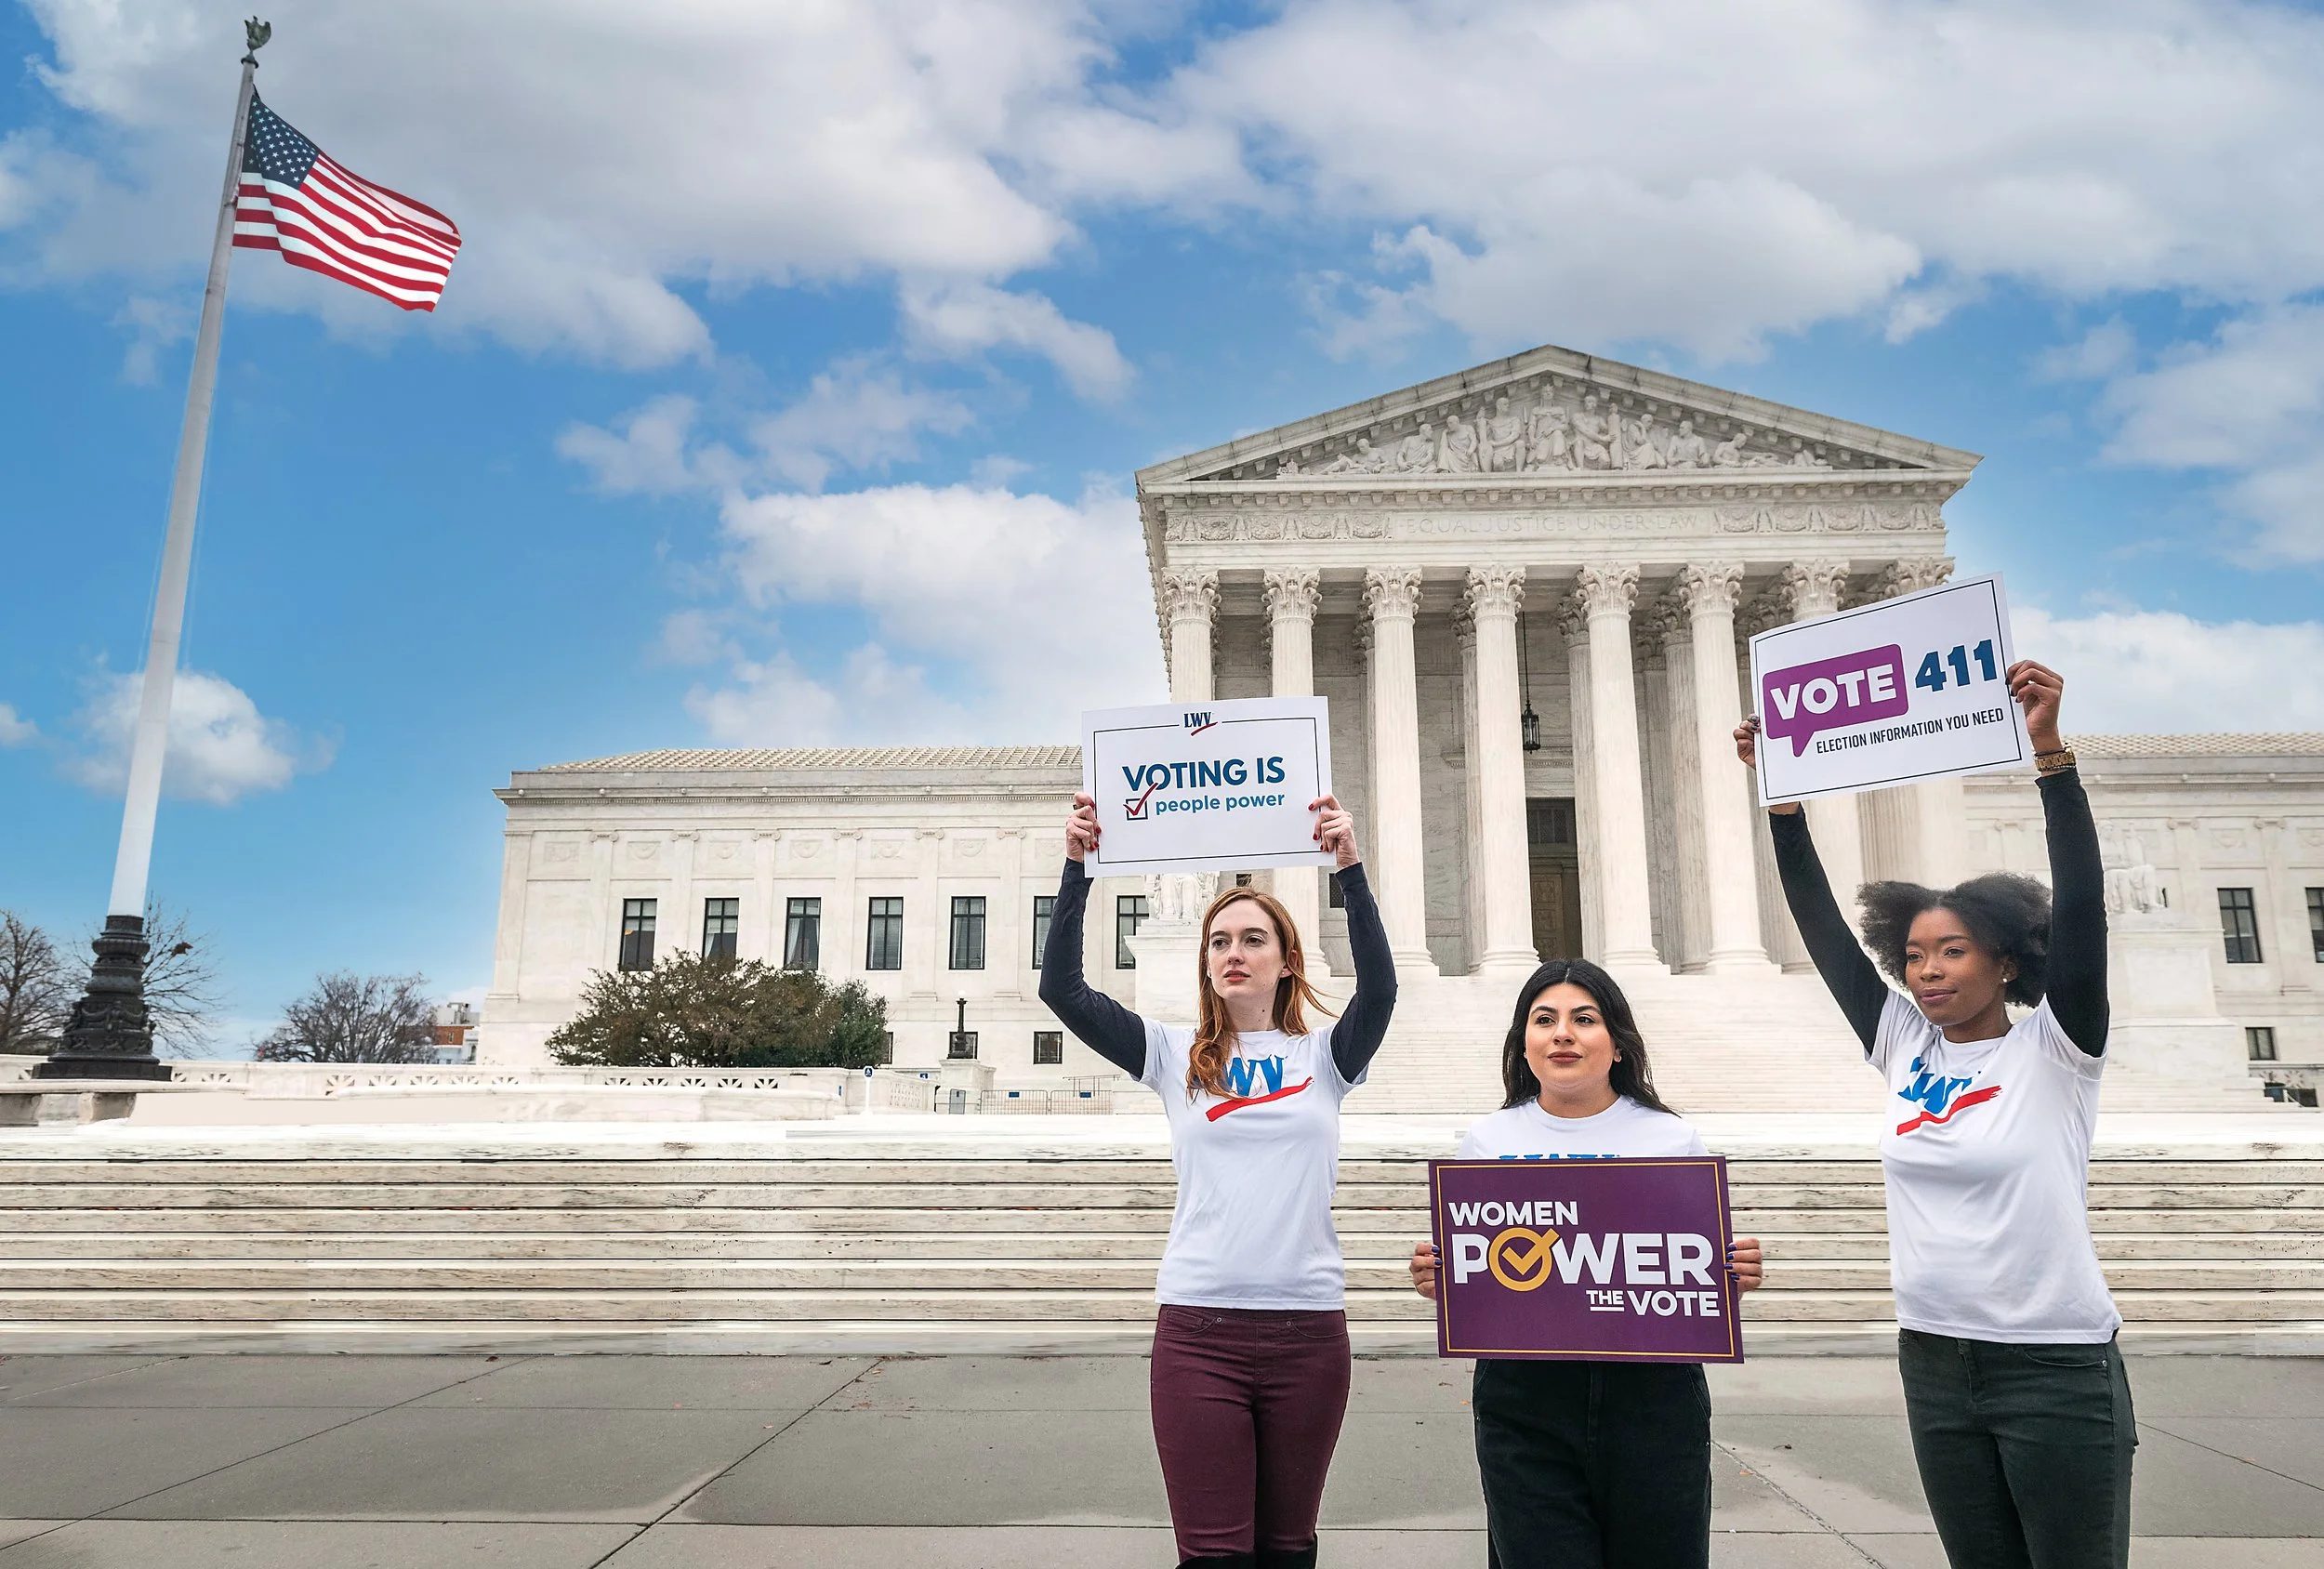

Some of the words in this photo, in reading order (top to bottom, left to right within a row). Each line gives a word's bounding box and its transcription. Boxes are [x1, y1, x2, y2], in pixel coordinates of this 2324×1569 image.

[1406, 518, 1477, 534] EQUAL
[1484, 515, 1565, 533] JUSTICE
[1577, 514, 1649, 531] UNDER
[1657, 513, 1697, 529] LAW
[1770, 663, 1897, 720] VOTE
[1915, 639, 1997, 692] 411
[1183, 712, 1212, 728] LWV
[1816, 734, 1867, 753] ELECTION
[1868, 719, 1944, 745] INFORMATION
[1945, 716, 1970, 732] YOU
[1973, 706, 2005, 726] NEED
[1122, 758, 1248, 791] VOTING
[1257, 756, 1286, 784] IS
[1155, 794, 1221, 815] people
[1225, 793, 1286, 811] power
[1447, 1200, 1579, 1226] WOMEN
[1451, 1226, 1717, 1292] POWER
[1586, 1289, 1624, 1305] THE
[1627, 1290, 1720, 1317] VOTE
